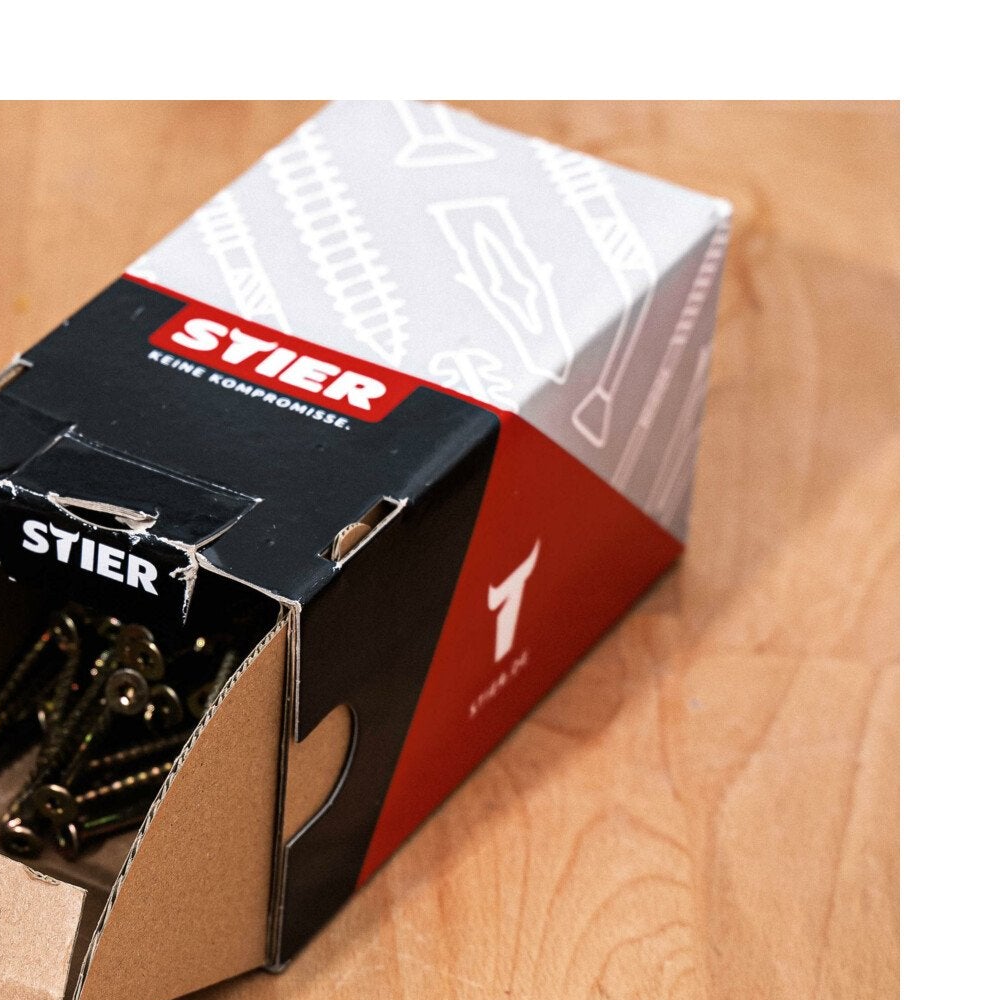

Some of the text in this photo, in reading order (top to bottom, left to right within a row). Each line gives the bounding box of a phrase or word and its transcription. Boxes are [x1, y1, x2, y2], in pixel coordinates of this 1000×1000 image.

[147, 350, 350, 430] KEINE KOMPROMISSE.
[171, 318, 387, 411] STIER
[22, 519, 159, 596] STIER
